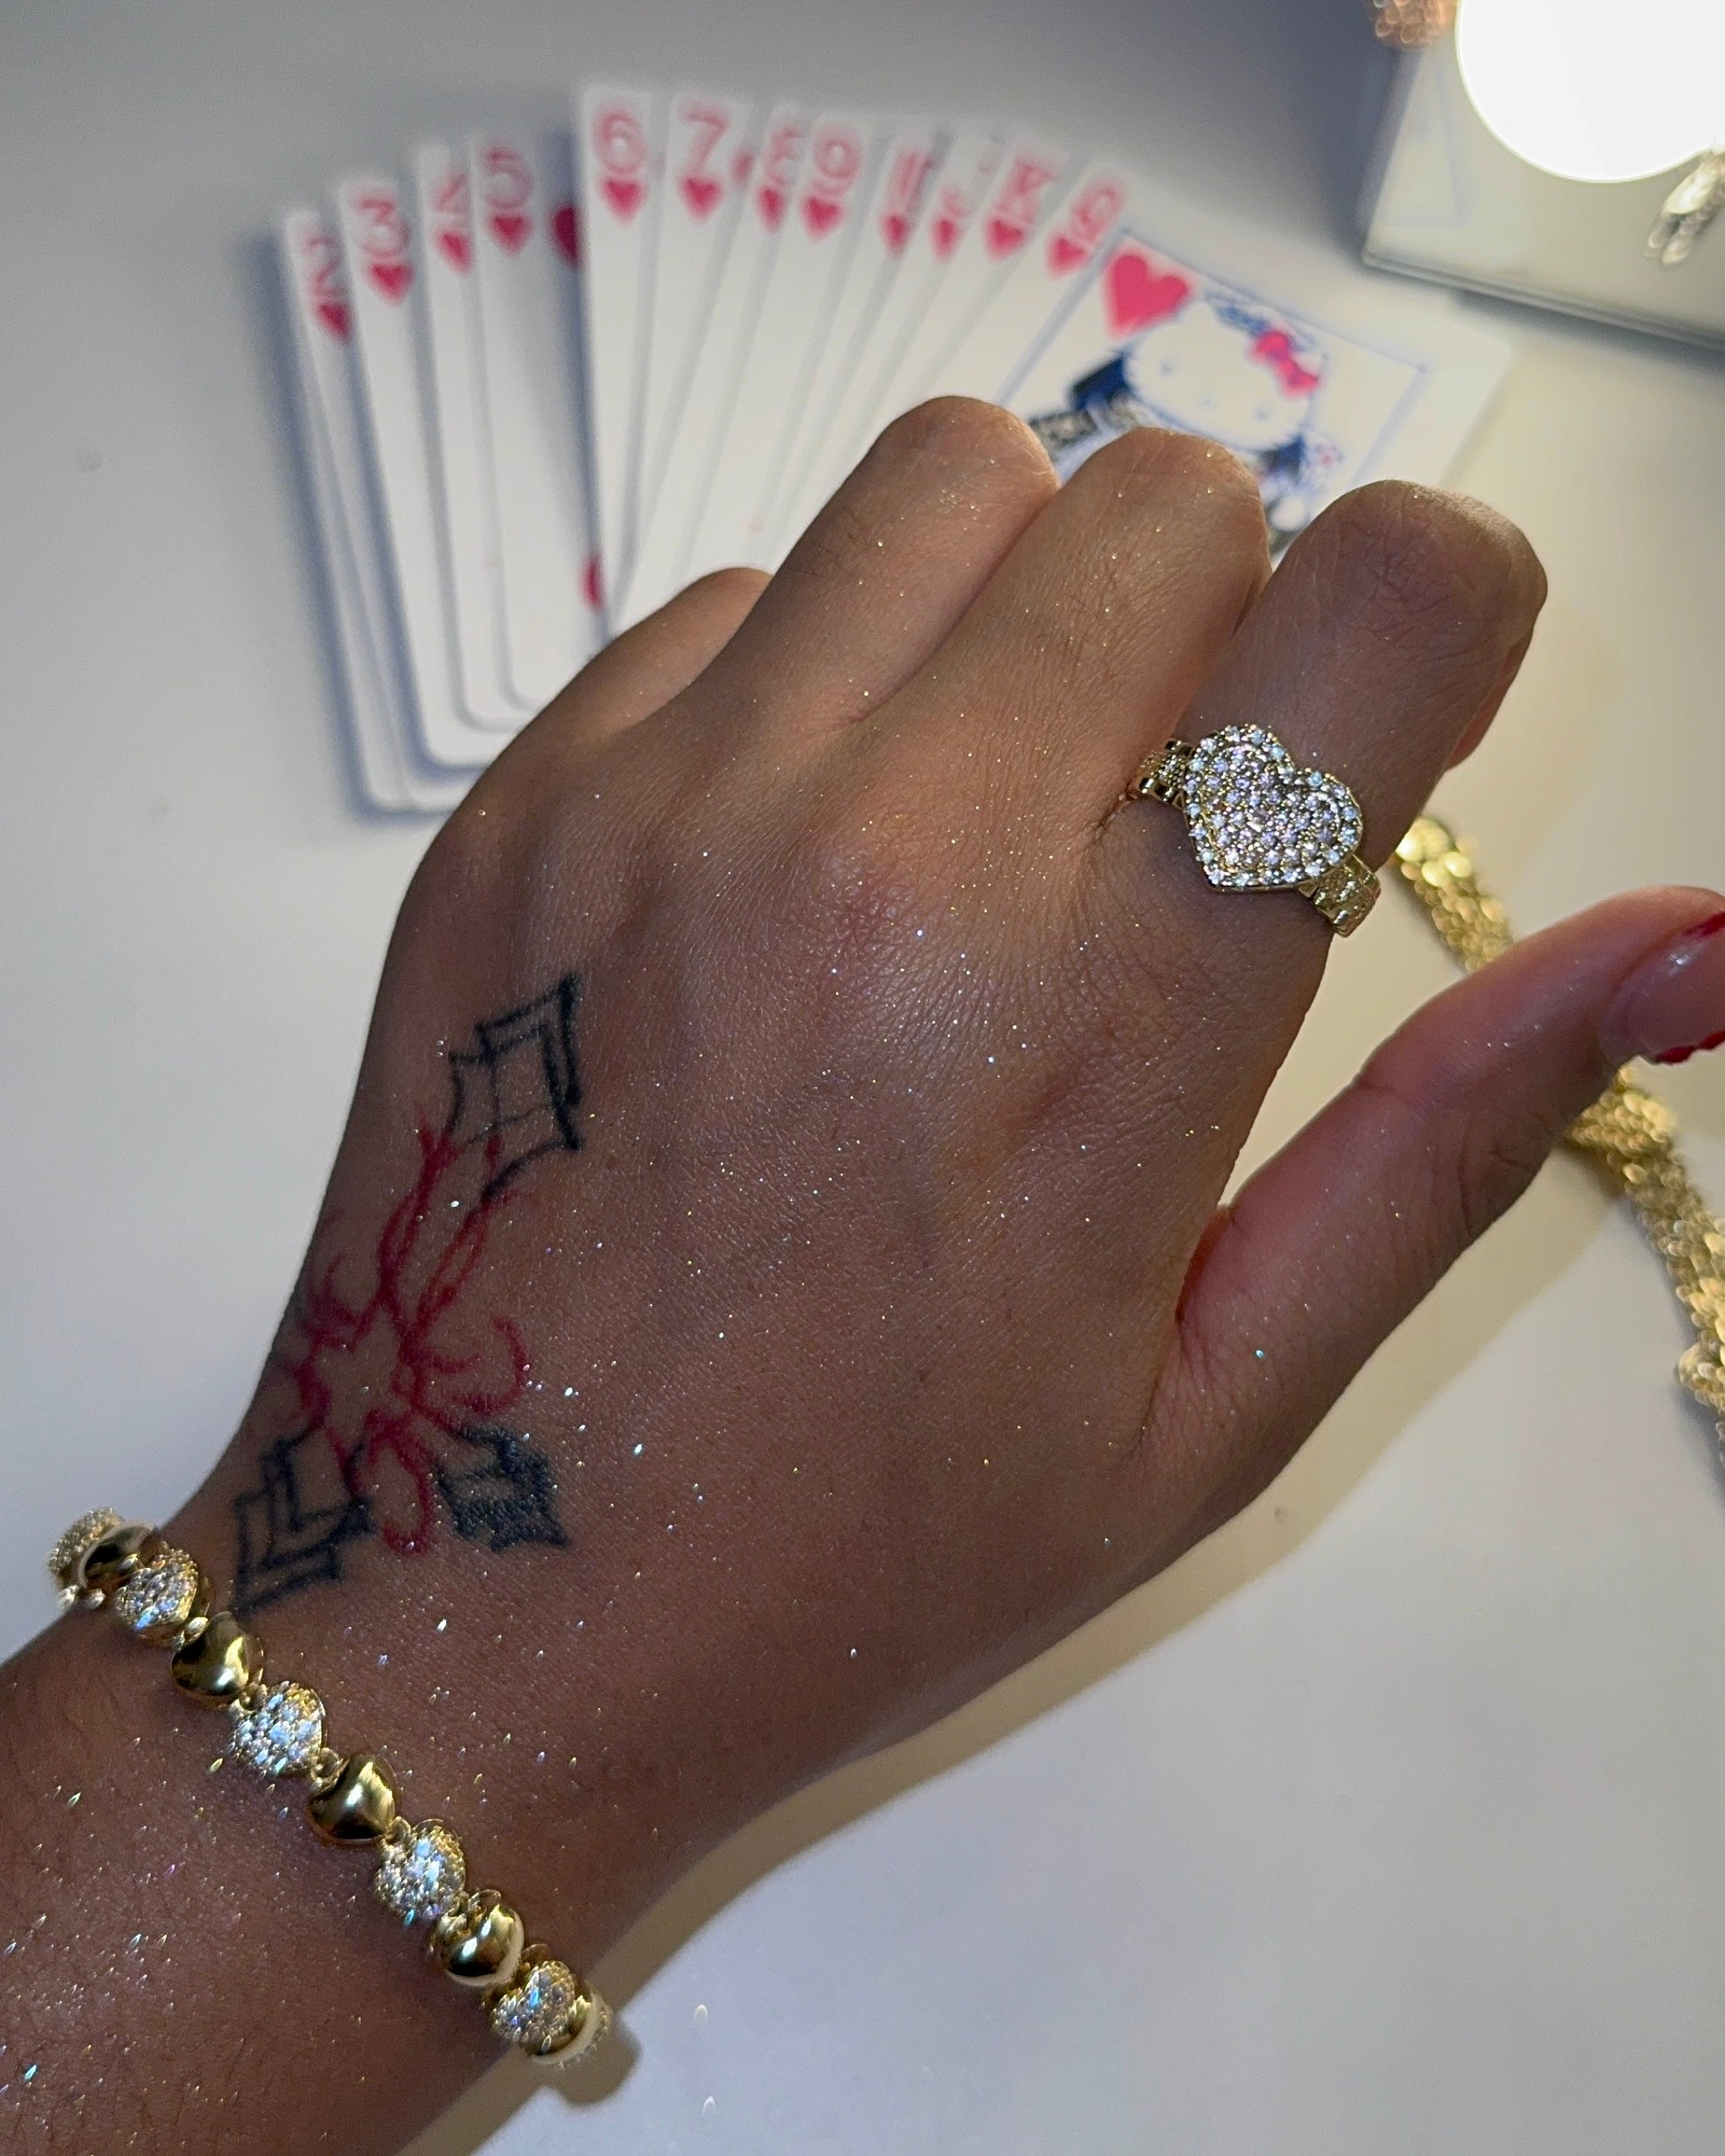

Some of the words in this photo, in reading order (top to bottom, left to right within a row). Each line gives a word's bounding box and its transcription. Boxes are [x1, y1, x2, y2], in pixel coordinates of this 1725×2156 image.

[594, 106, 649, 176] 6
[676, 103, 731, 176] 7
[480, 142, 534, 212] 5
[354, 192, 411, 260] 3
